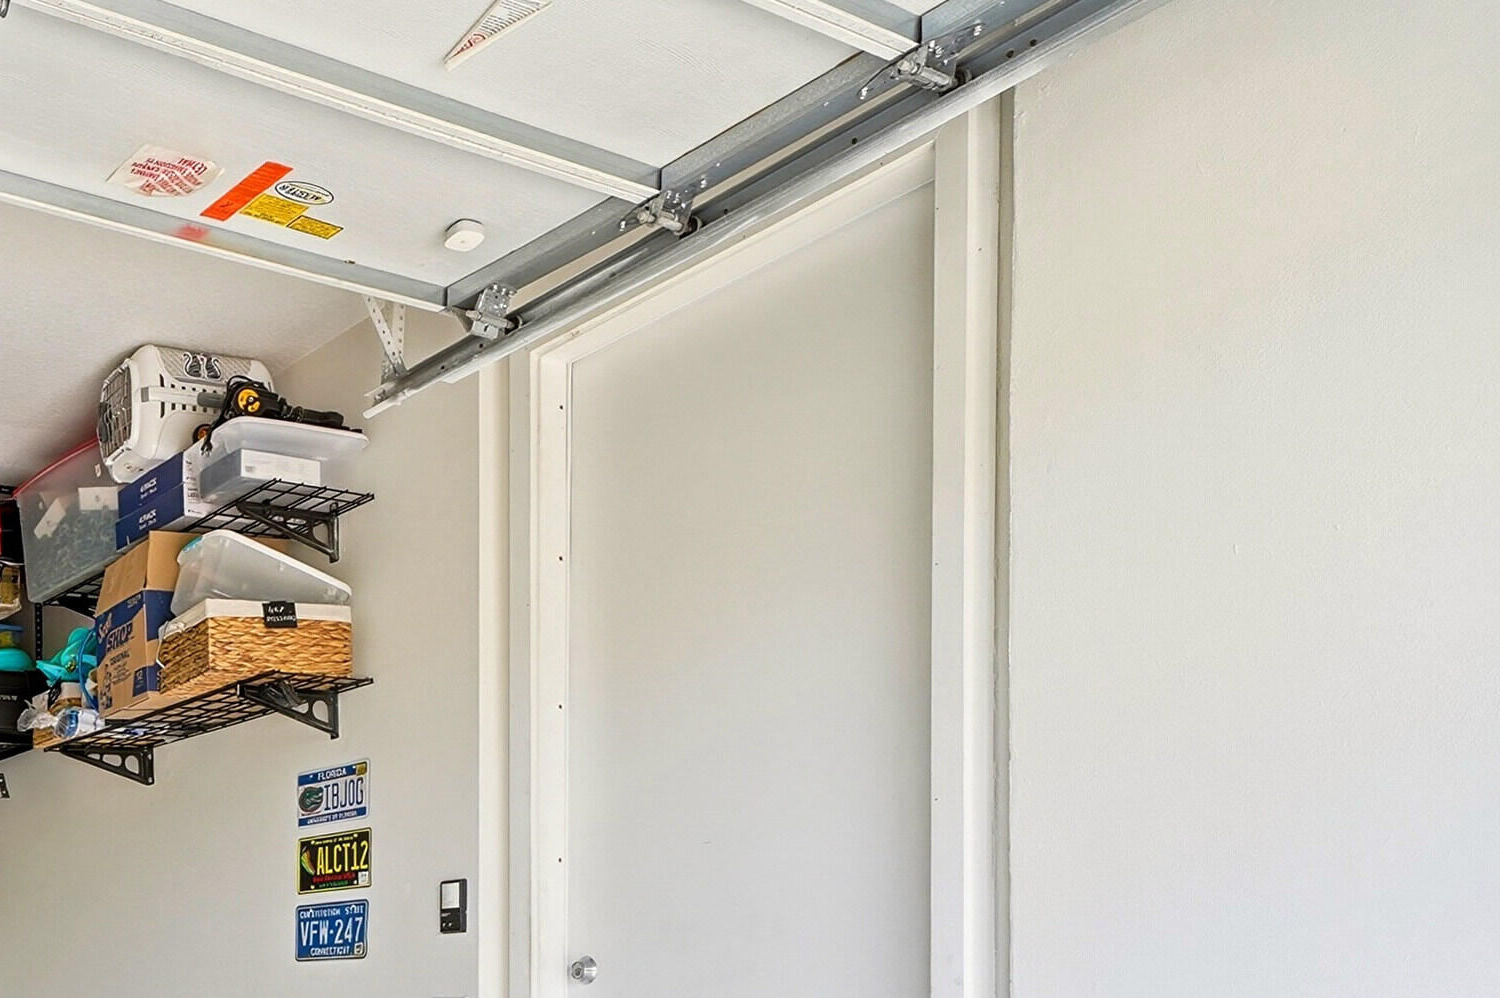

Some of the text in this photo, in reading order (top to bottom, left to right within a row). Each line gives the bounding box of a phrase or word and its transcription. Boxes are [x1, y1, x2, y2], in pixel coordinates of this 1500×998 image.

[106, 621, 134, 652] SHOP
[317, 767, 347, 780] FLORIDA
[316, 840, 368, 876] ALCT12
